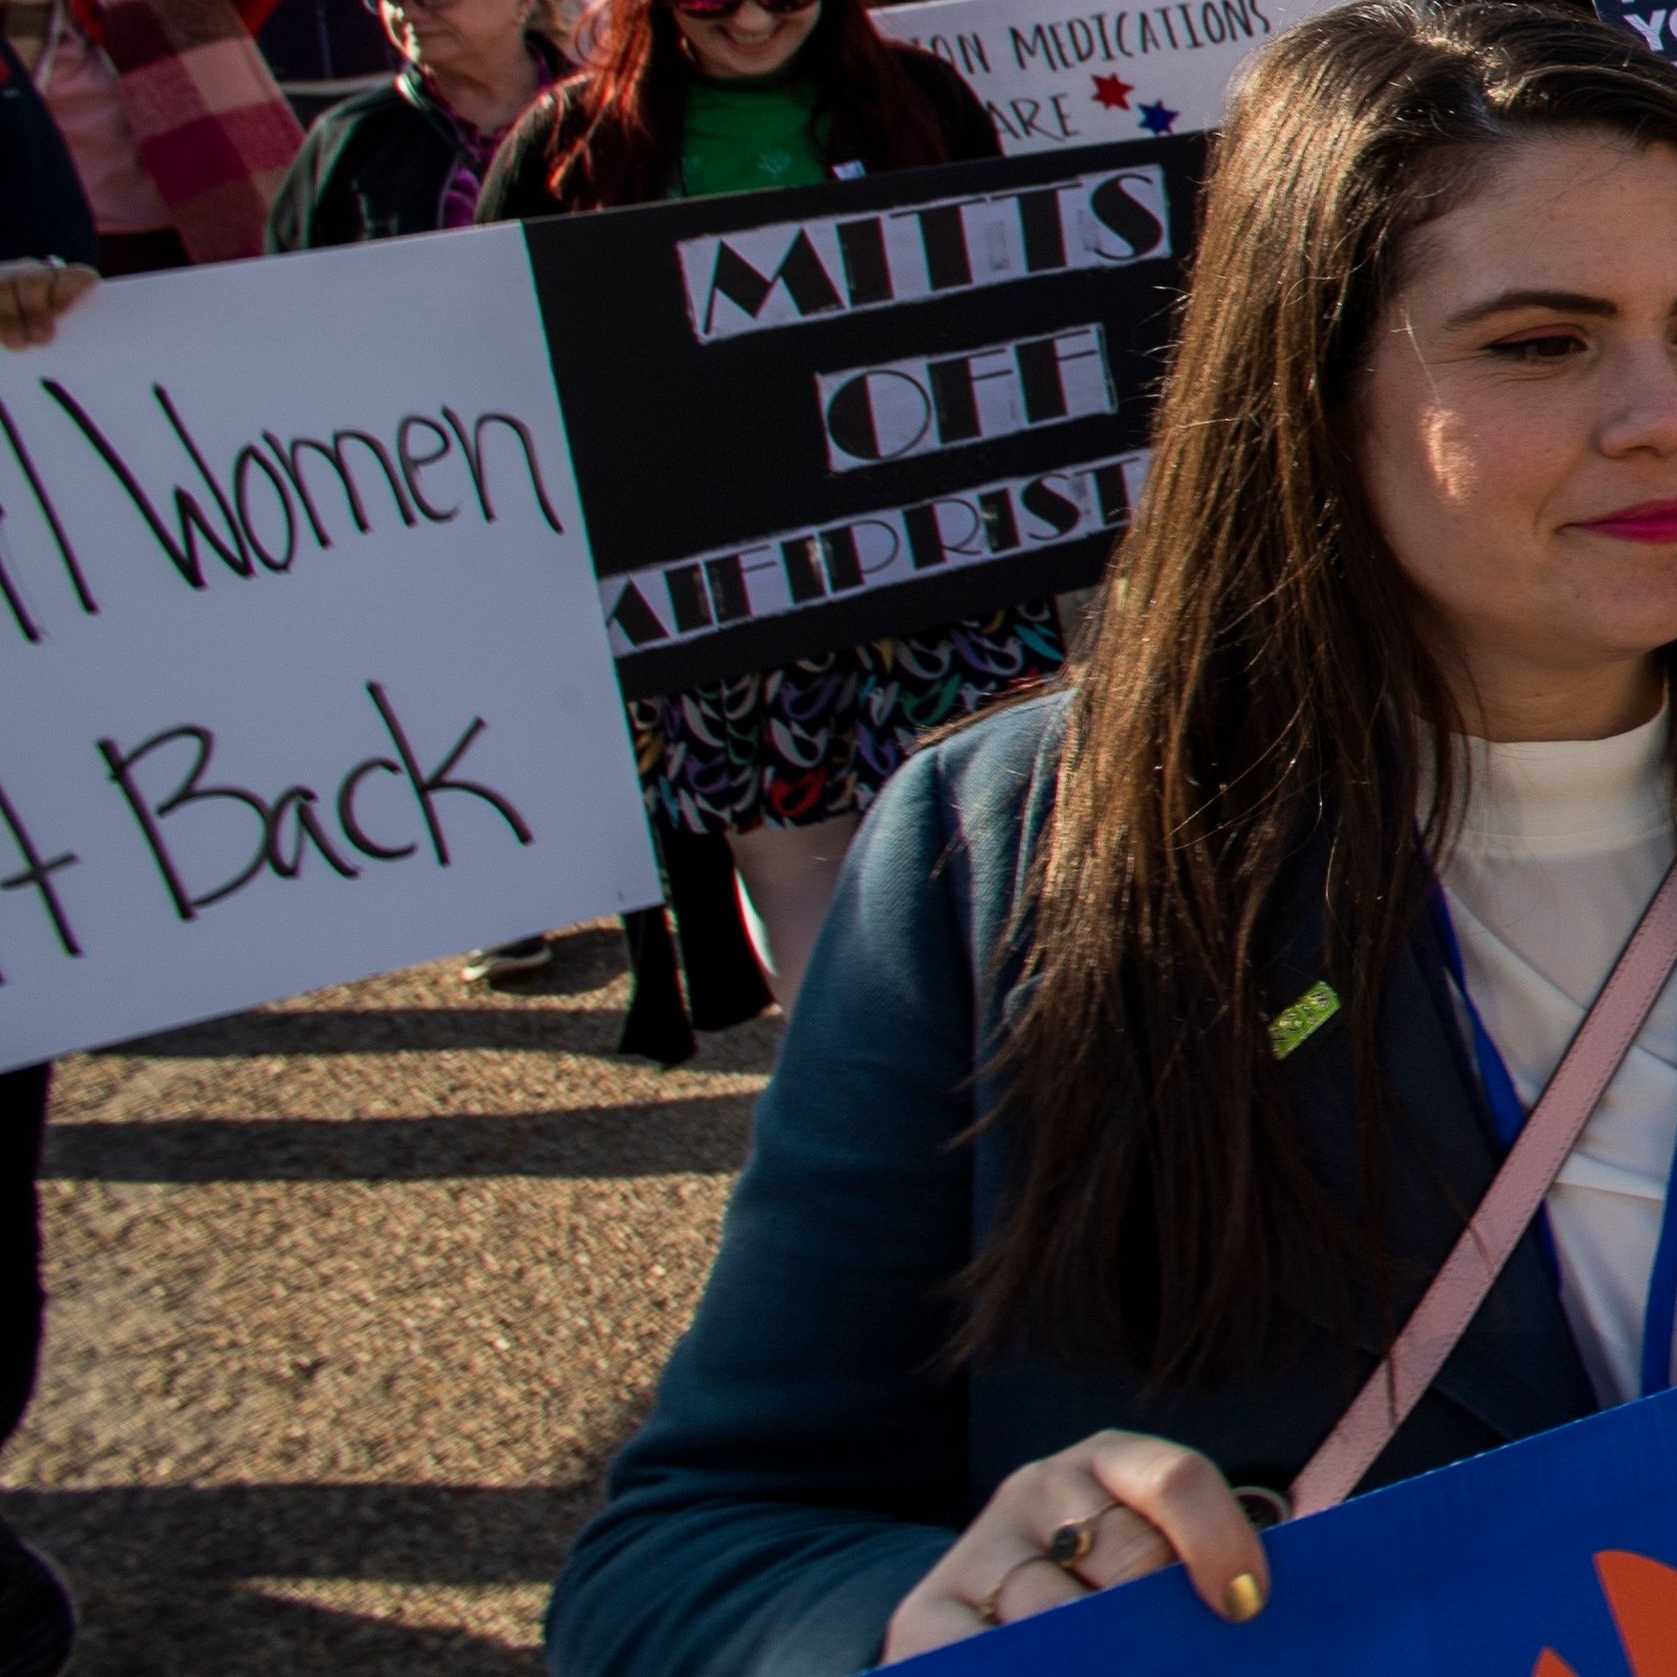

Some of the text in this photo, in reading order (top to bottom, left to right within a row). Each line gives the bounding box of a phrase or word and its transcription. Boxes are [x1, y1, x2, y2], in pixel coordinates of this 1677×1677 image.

[704, 173, 1165, 338] MITTS
[41, 377, 564, 590] Women
[825, 328, 1098, 461] OFF
[96, 680, 534, 922] Back
